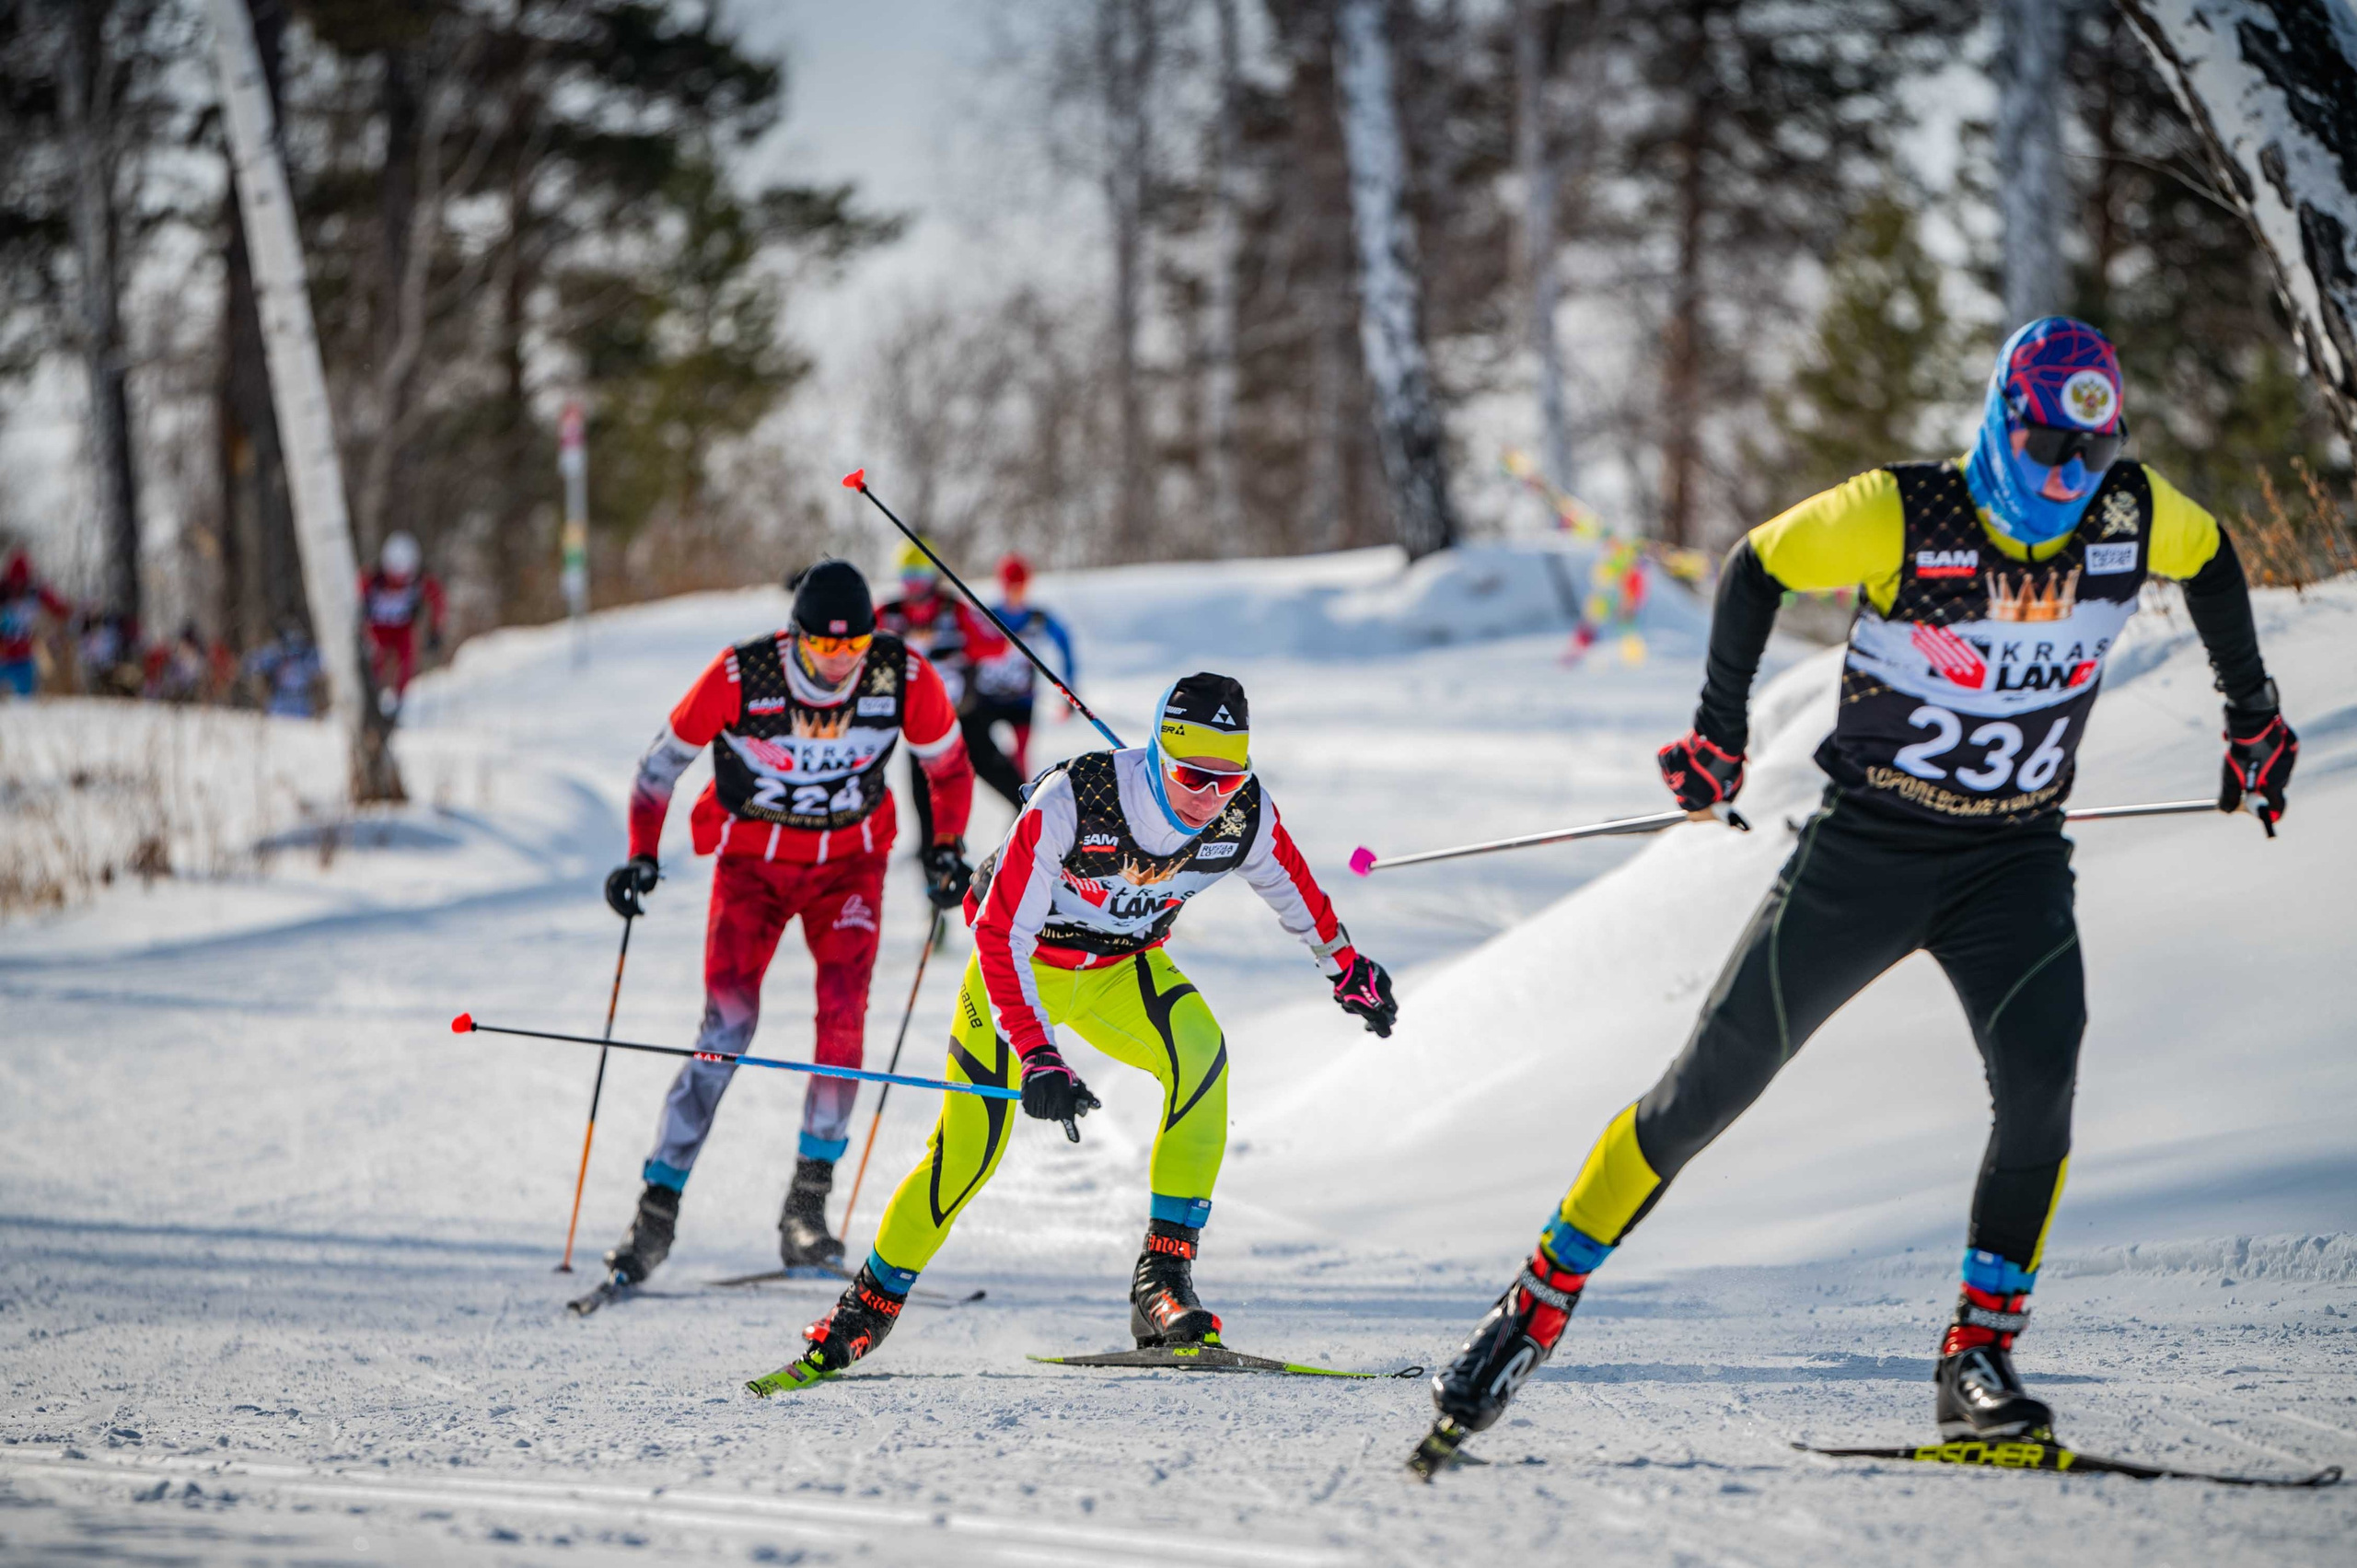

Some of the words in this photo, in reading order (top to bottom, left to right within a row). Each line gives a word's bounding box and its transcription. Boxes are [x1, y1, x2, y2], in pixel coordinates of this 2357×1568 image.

[2002, 638, 2109, 662] KRAS
[1894, 705, 2071, 792] 236
[1913, 1441, 2045, 1469] FISCHER
